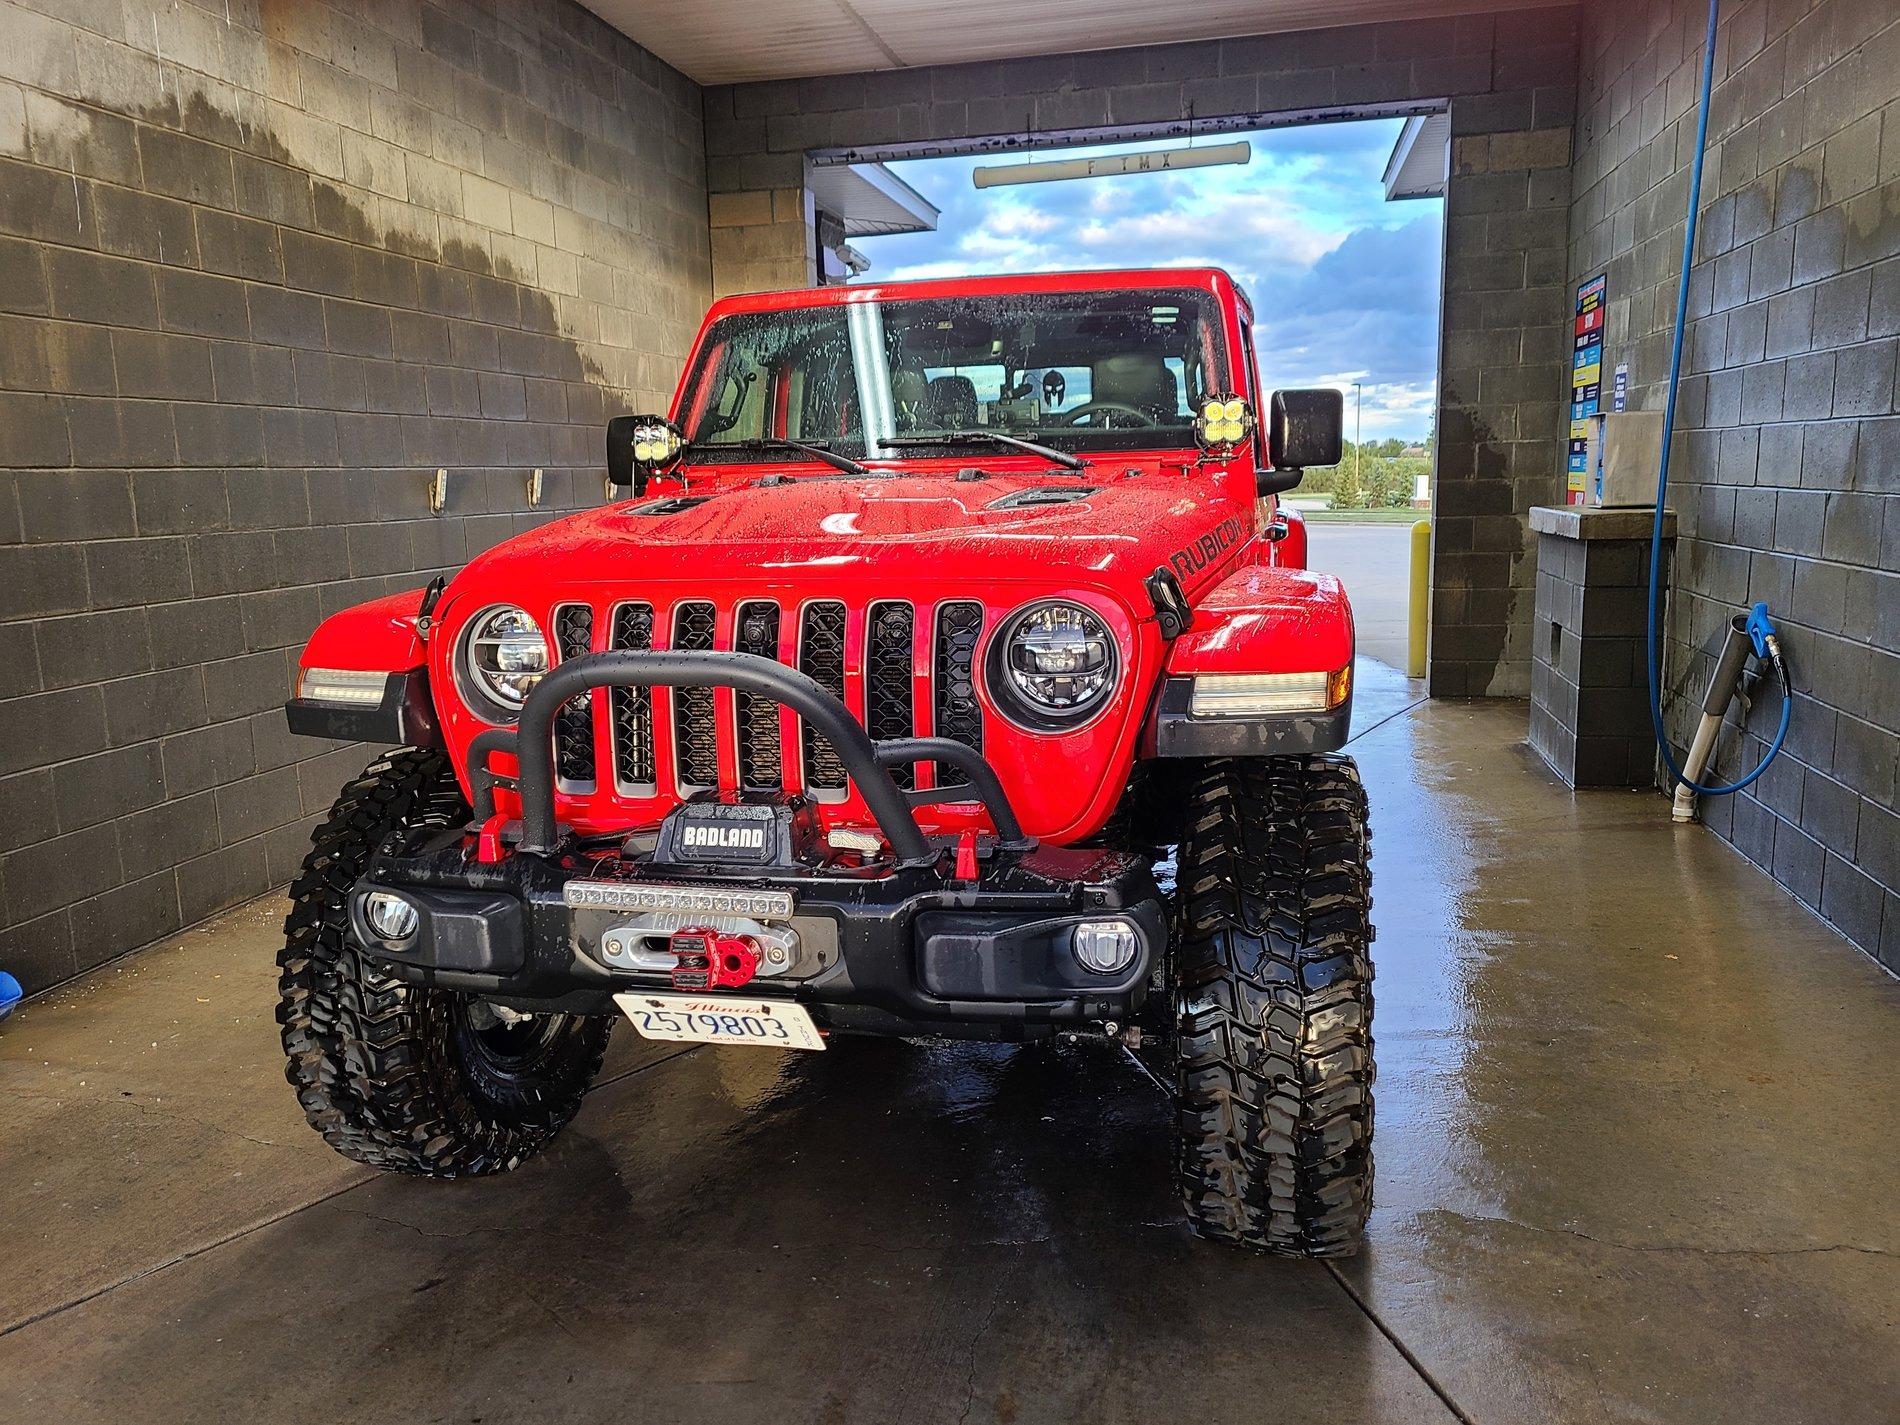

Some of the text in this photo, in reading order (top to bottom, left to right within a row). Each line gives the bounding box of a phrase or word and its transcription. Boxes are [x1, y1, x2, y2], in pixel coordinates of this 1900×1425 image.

[1170, 514, 1243, 581] RUBICON
[683, 826, 764, 848] BADLAND
[685, 1003, 761, 1014] Illinois
[633, 1011, 789, 1038] 2579803
